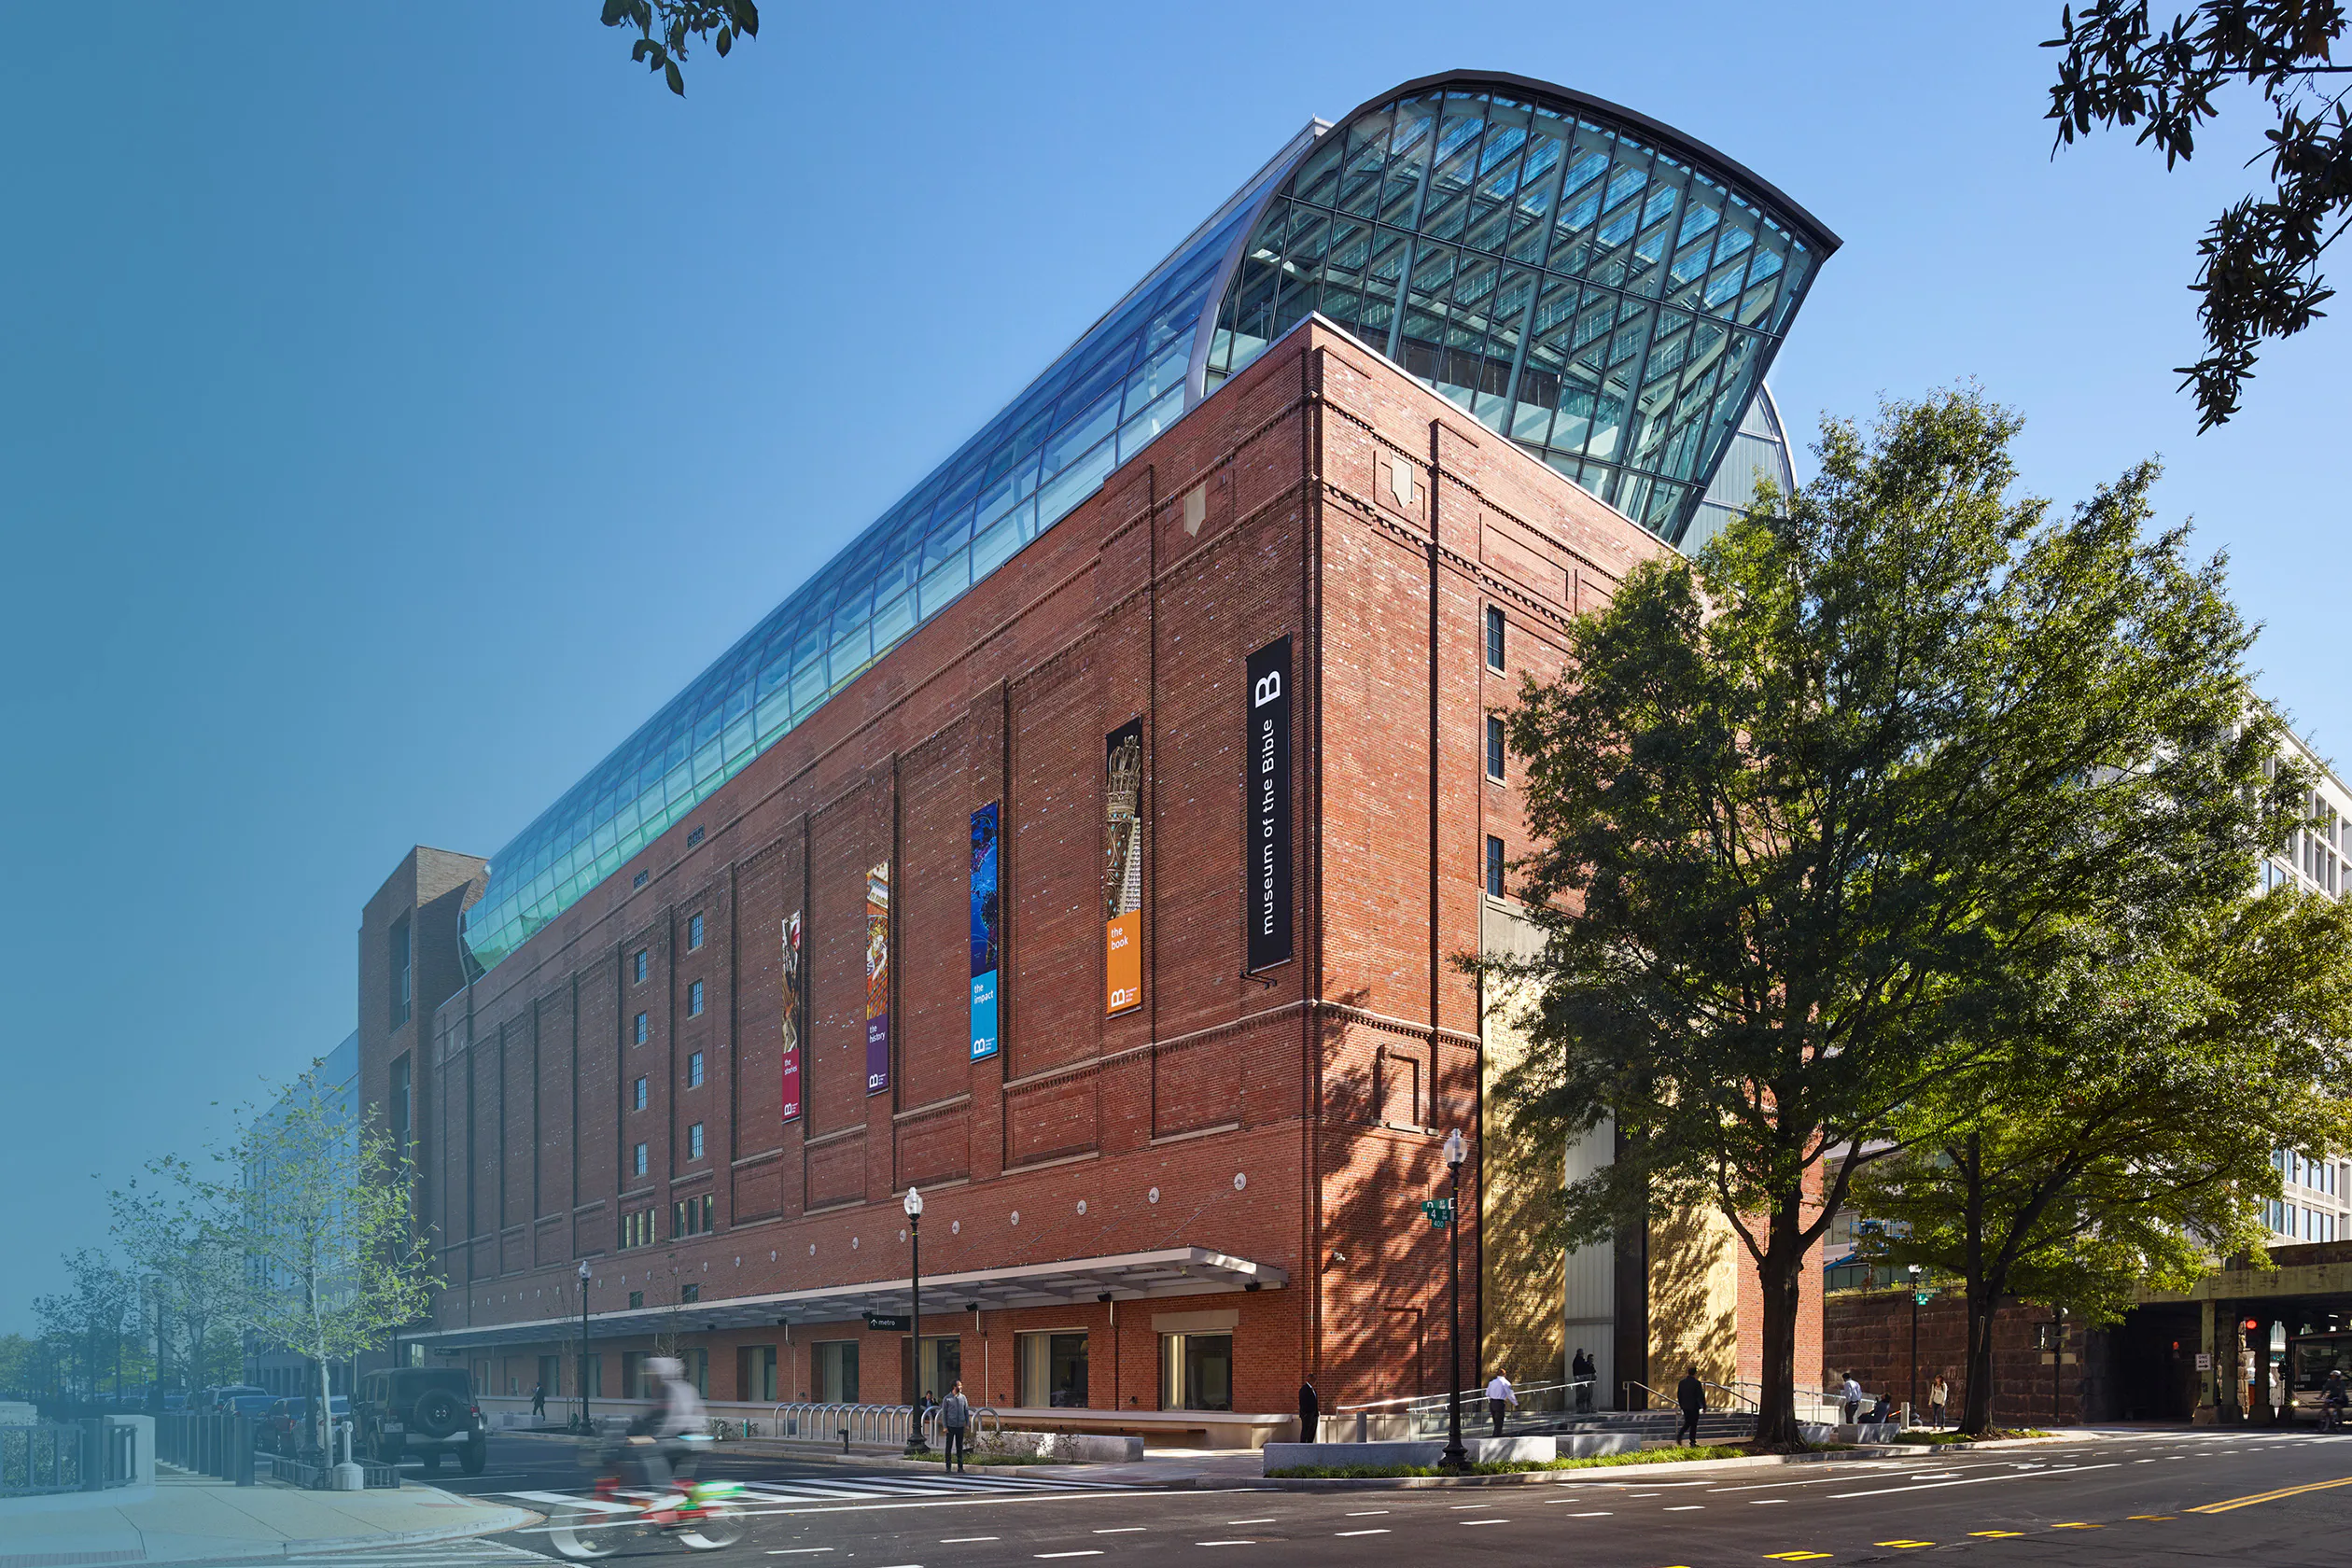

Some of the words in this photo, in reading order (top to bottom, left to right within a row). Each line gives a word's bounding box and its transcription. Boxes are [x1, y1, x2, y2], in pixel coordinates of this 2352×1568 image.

[1254, 670, 1281, 708] B
[1262, 720, 1274, 775] Bible
[1262, 778, 1275, 814] the
[1262, 818, 1275, 838] of
[1263, 843, 1274, 936] museum
[1111, 926, 1123, 938] the
[1111, 935, 1128, 950] book
[973, 983, 984, 994] the
[973, 989, 994, 1004] impact
[1111, 988, 1126, 1008] B
[869, 1025, 877, 1033] the
[869, 1031, 886, 1043] history
[973, 1038, 986, 1055] B
[784, 1065, 797, 1075] stories
[869, 1073, 878, 1088] B
[1431, 1209, 1436, 1219] 4
